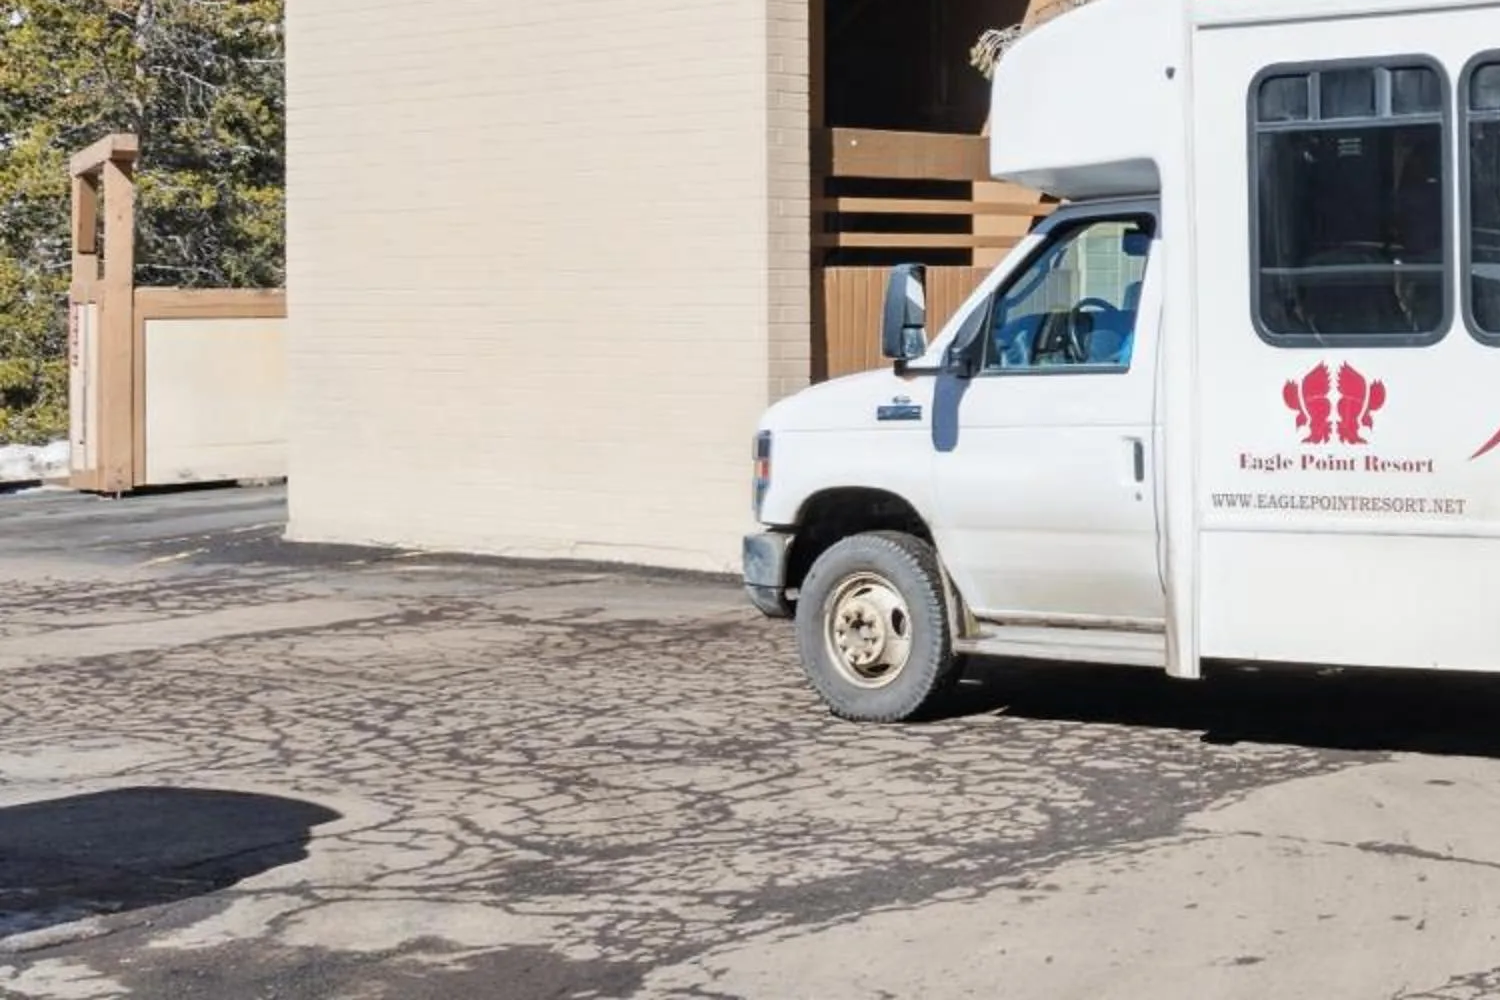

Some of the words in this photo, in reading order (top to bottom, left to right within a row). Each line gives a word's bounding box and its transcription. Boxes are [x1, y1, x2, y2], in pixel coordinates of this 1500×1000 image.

[1239, 453, 1294, 472] Eagle
[1301, 454, 1356, 471] Point
[1364, 455, 1434, 473] Resort
[1211, 492, 1467, 516] WWW.EAGLEPOINTRESORT.NET
